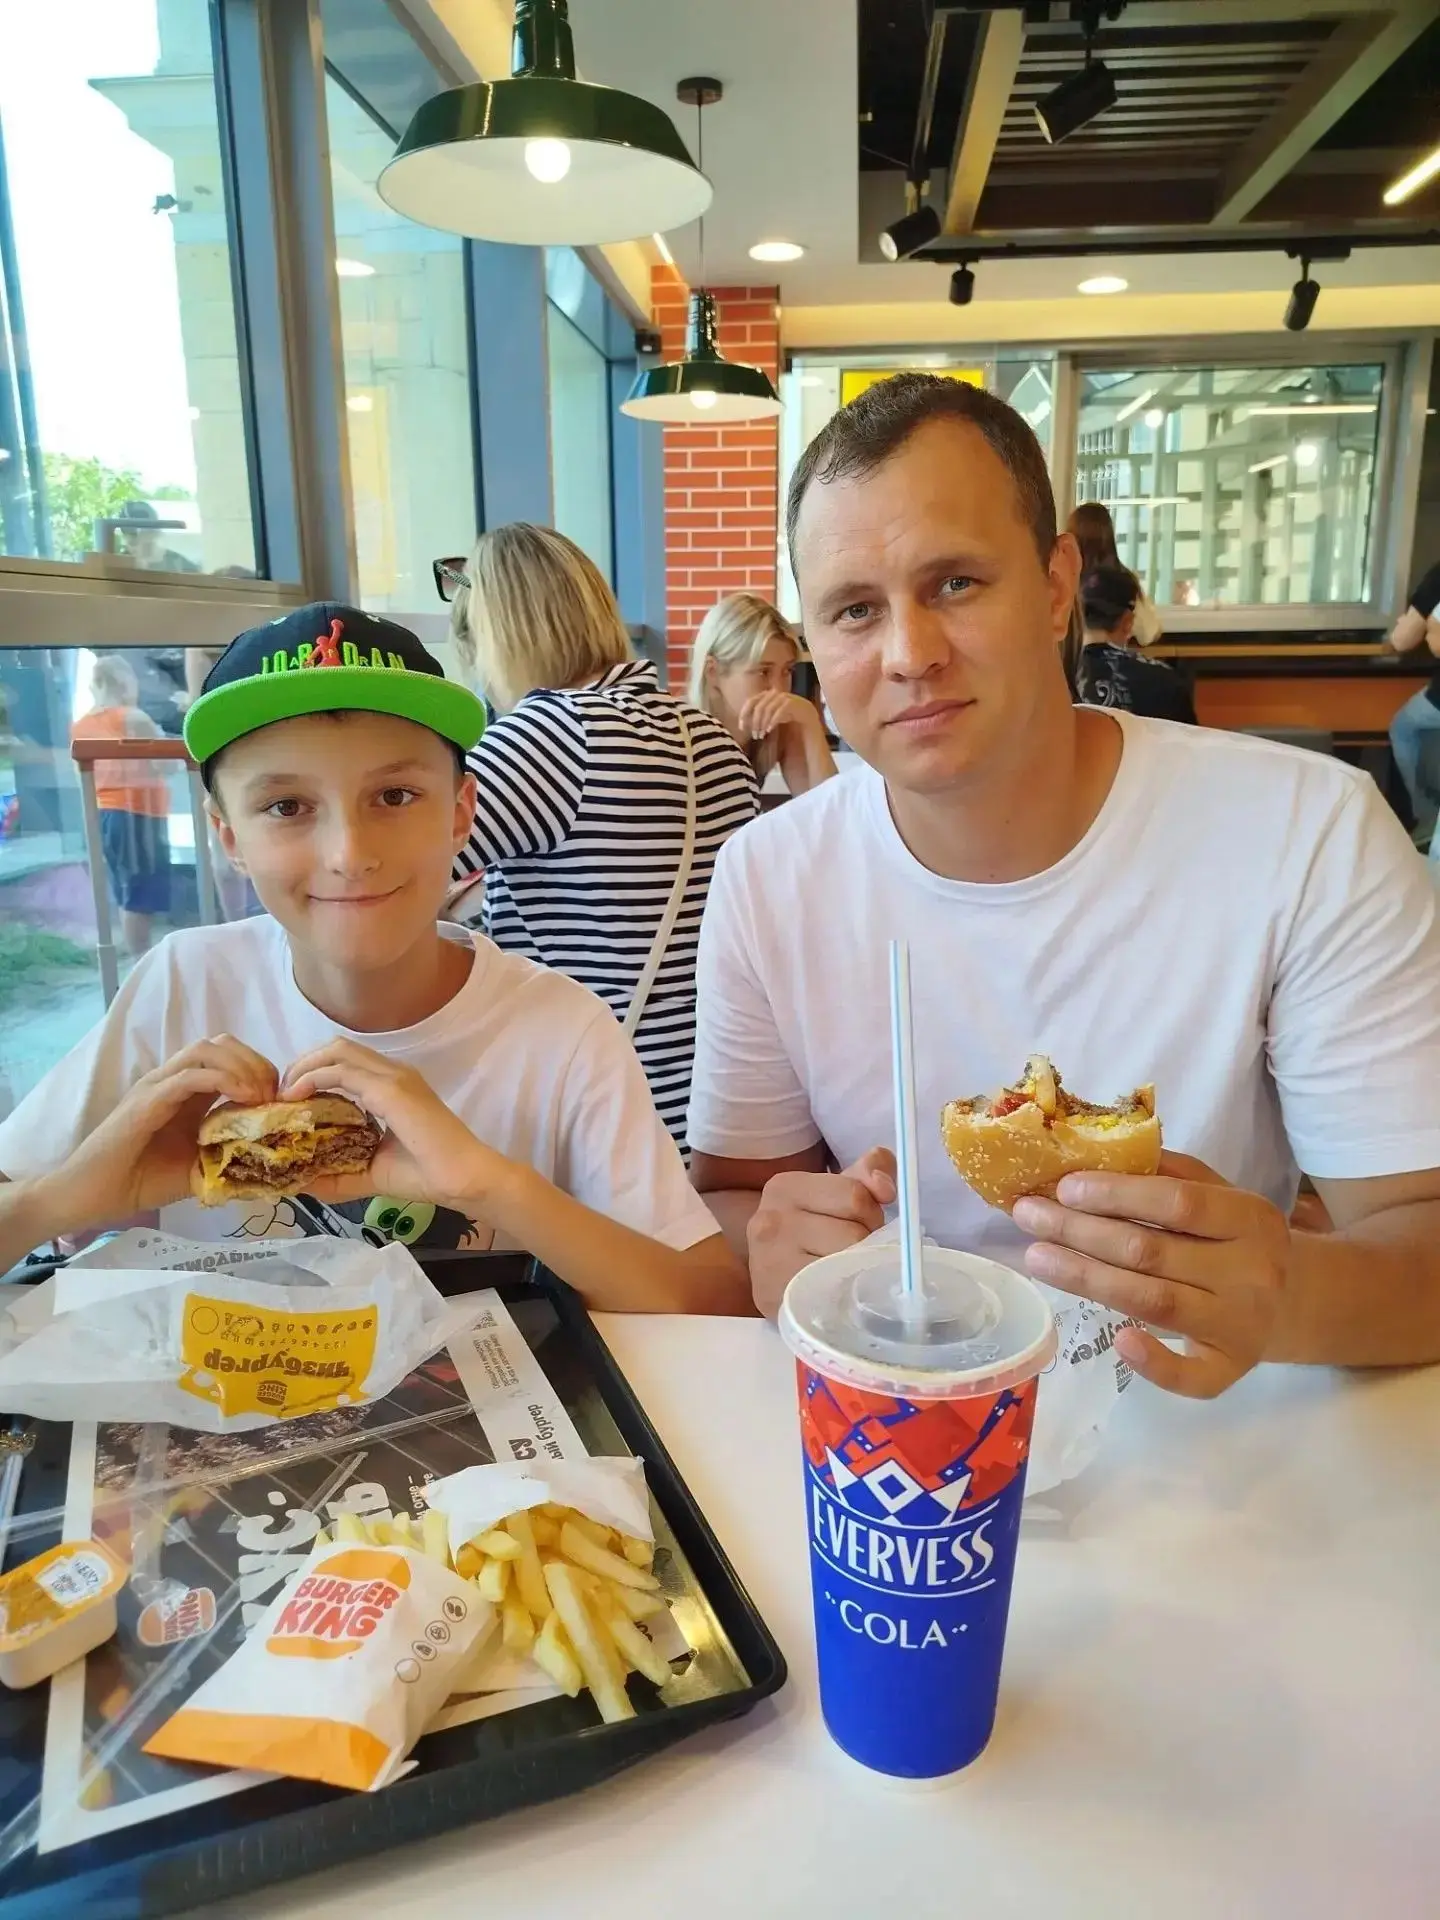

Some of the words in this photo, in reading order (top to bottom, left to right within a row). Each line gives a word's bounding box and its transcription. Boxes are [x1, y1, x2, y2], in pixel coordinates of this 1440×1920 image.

[528, 1404, 554, 1440] бургер
[812, 1484, 994, 1586] EVERVESS
[294, 1577, 400, 1610] BURGER
[273, 1599, 384, 1639] KING
[839, 1599, 948, 1649] COLA
